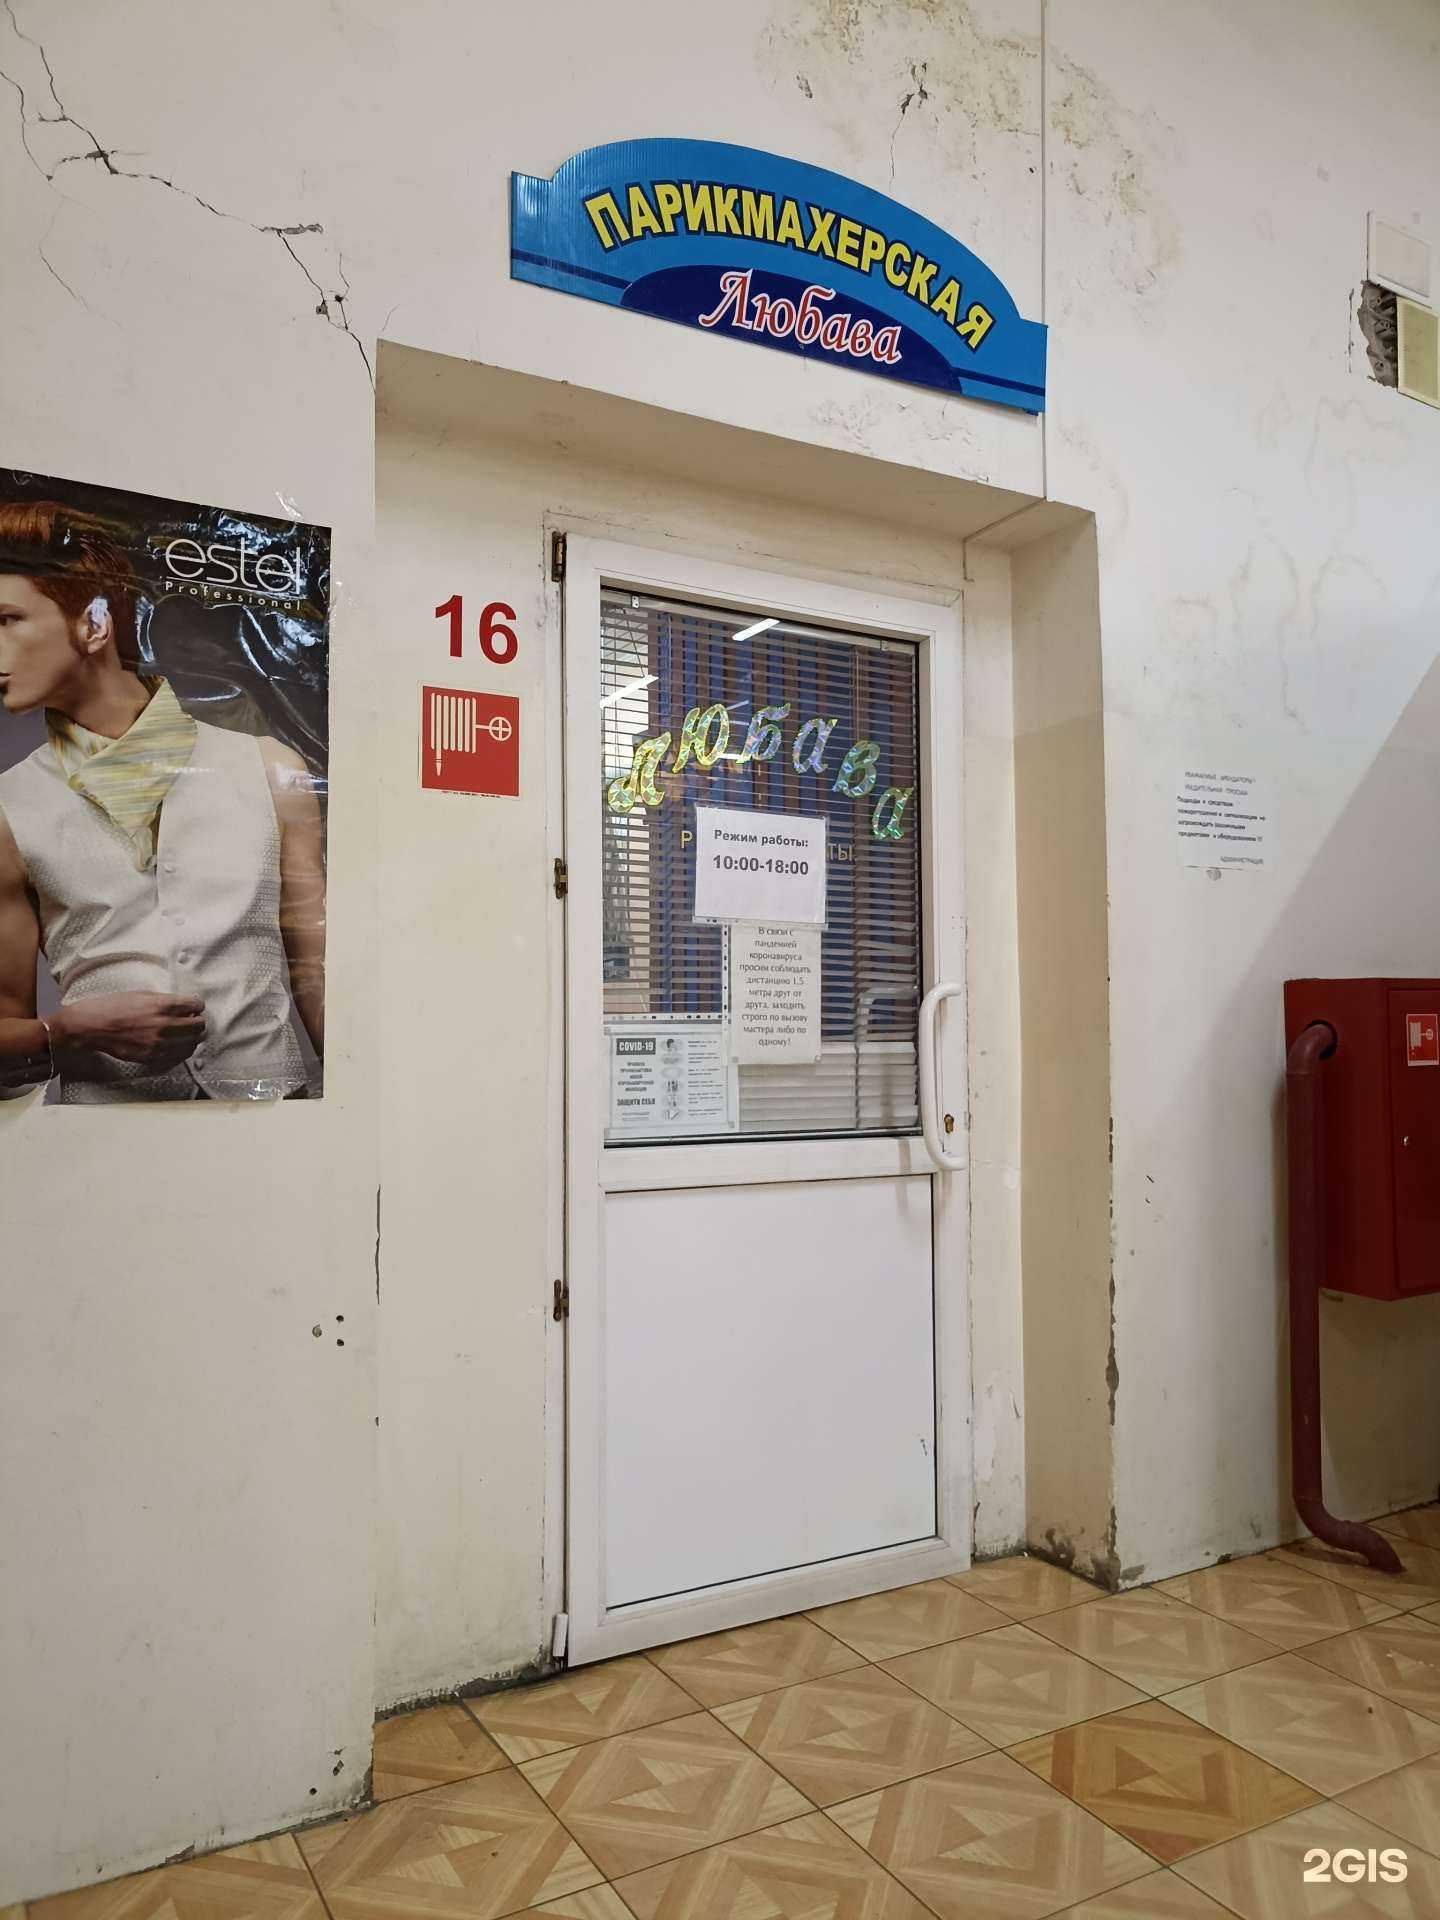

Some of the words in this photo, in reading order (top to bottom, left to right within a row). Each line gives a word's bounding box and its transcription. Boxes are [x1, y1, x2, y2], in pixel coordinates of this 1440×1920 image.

[583, 181, 996, 350] ПАРИКМАХЕРСКАЯ
[698, 267, 903, 365] Любава
[165, 536, 302, 595] estel
[165, 580, 301, 611] Professional
[434, 594, 519, 665] 16
[714, 829, 757, 844] Режим
[761, 835, 809, 848] работы:
[713, 854, 809, 876] 10:00-18:00
[754, 940, 797, 949] пандемией
[749, 952, 802, 961] коронавируса
[740, 963, 769, 973] просим
[770, 964, 812, 974] соблюдать
[746, 976, 791, 986] дистанцию
[748, 989, 772, 998] метра
[773, 989, 791, 999] друг
[793, 990, 802, 998] от
[741, 1013, 768, 1023] строго
[769, 1014, 780, 1022] по
[781, 1014, 808, 1023] вызову
[743, 1025, 775, 1036] мастера
[777, 1024, 795, 1034] либо
[796, 1026, 807, 1034] по
[619, 1042, 654, 1052] COVID-19
